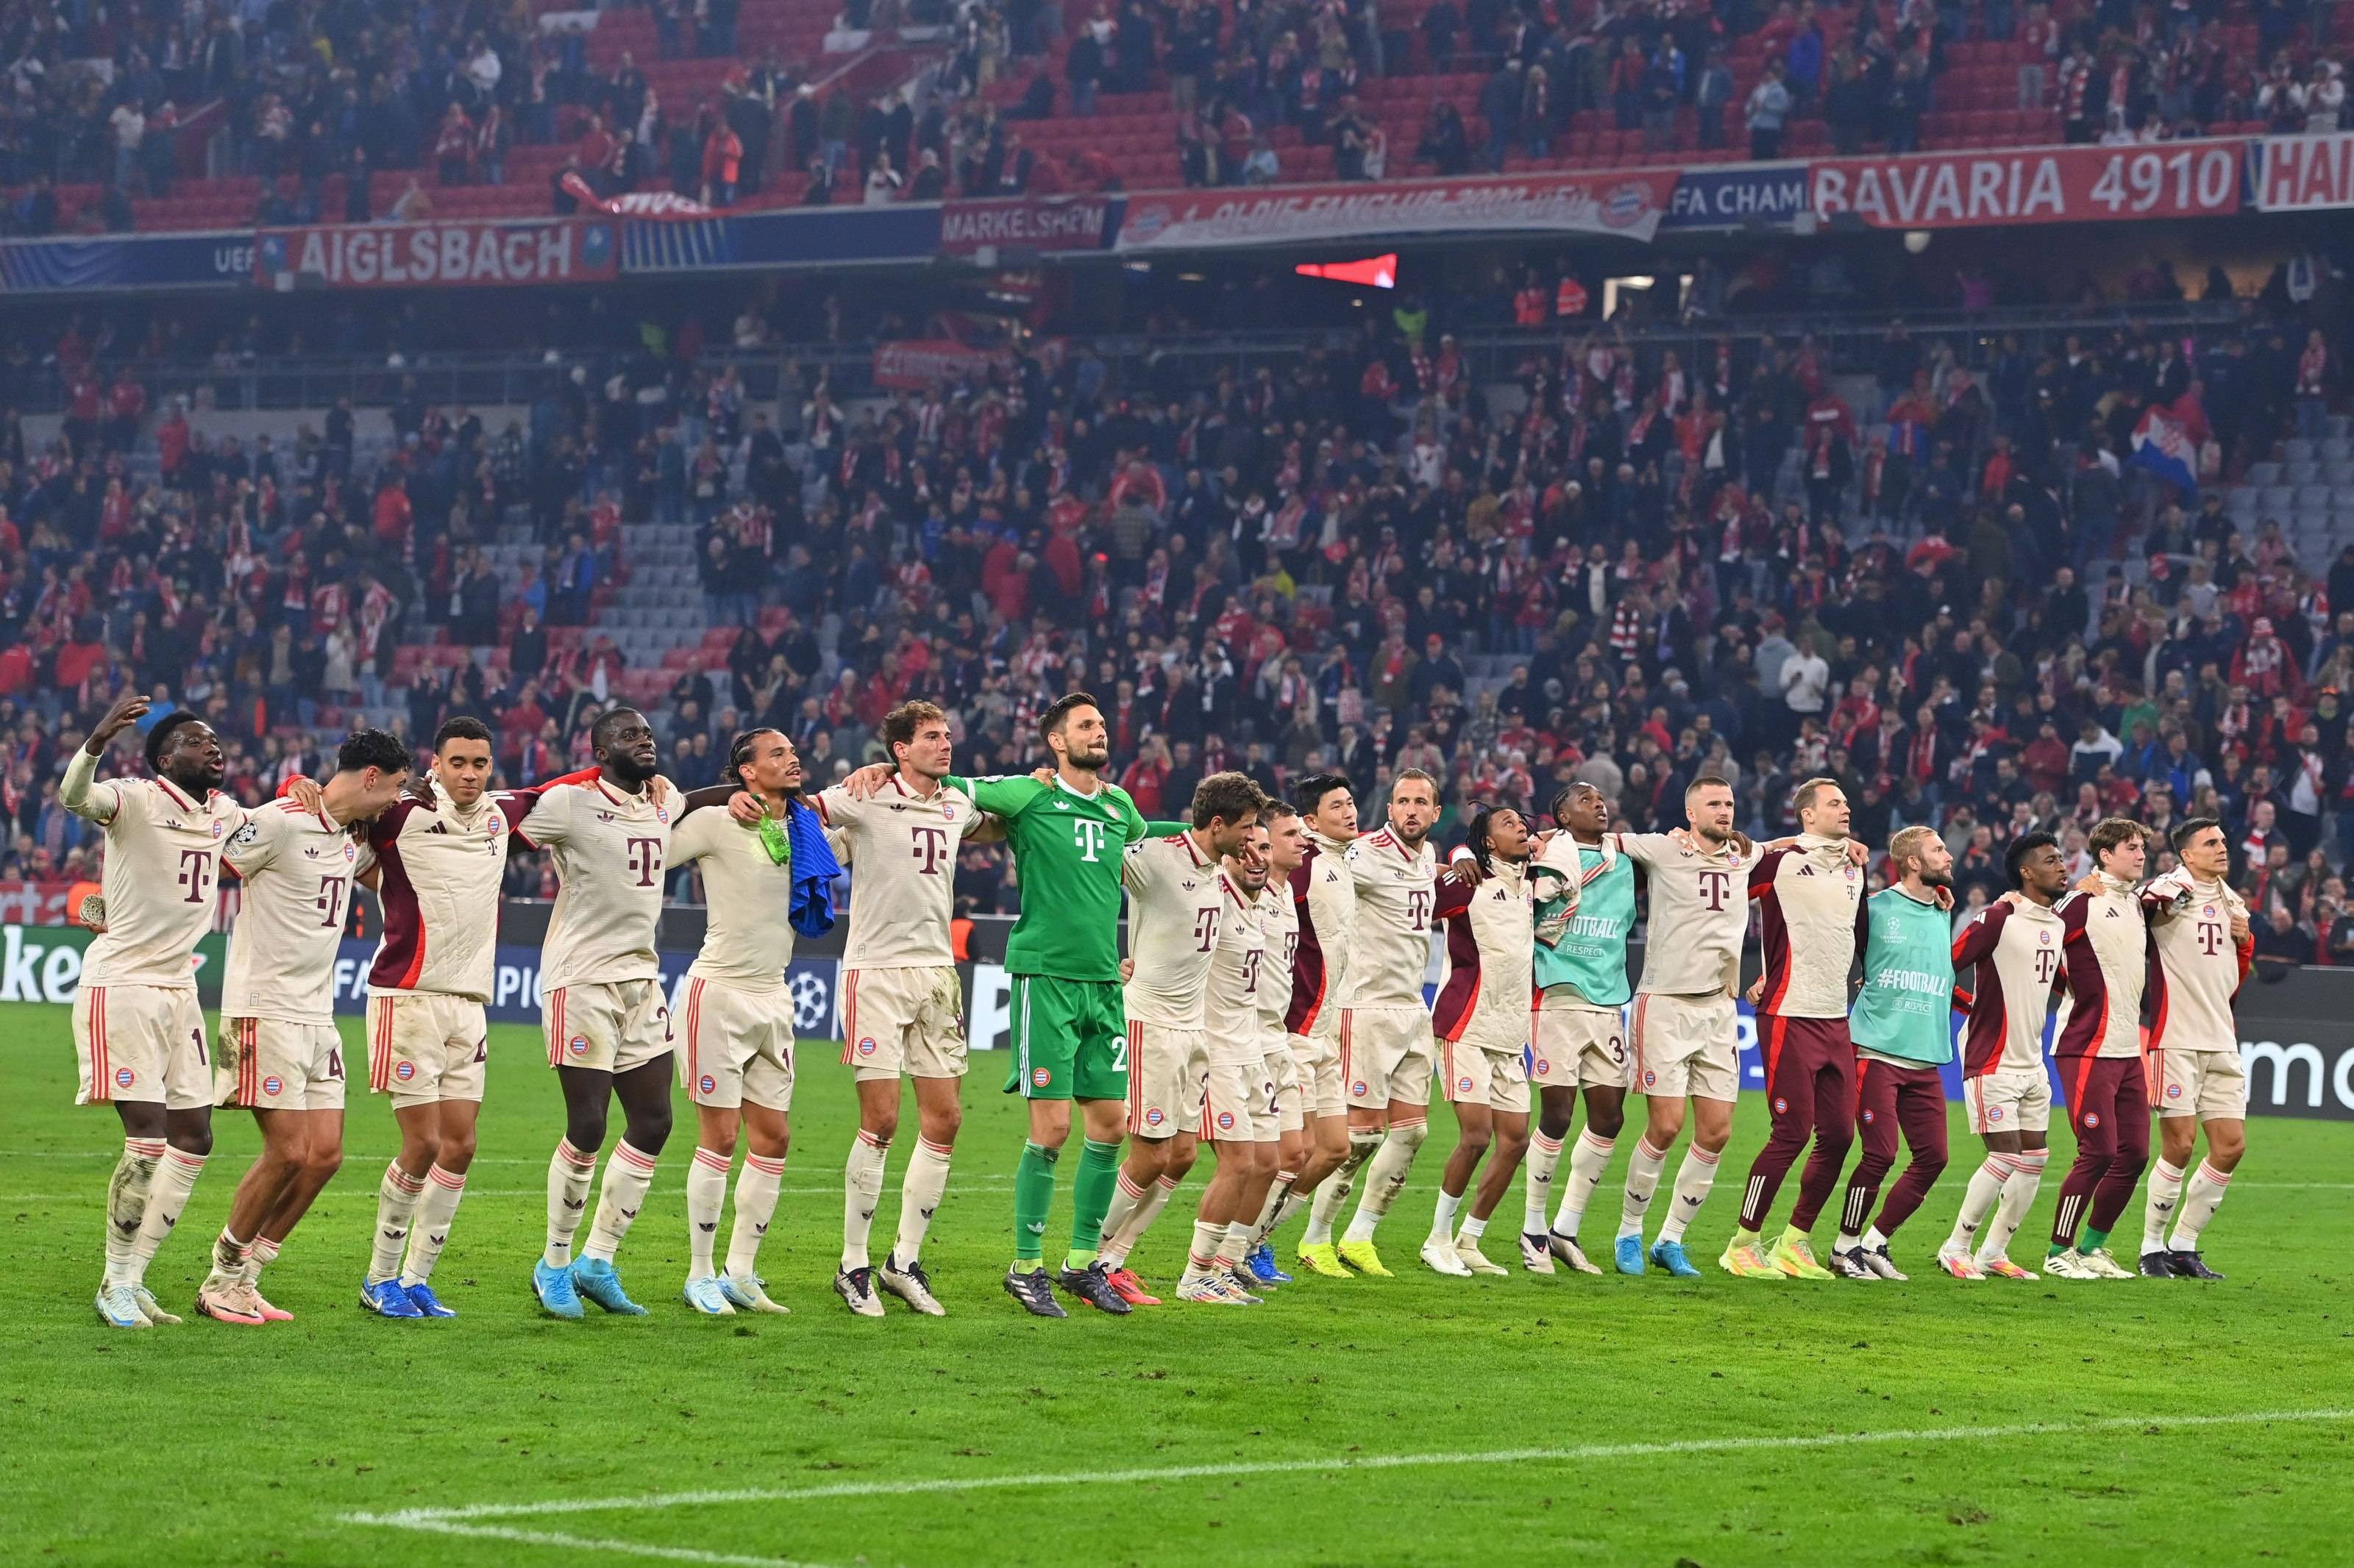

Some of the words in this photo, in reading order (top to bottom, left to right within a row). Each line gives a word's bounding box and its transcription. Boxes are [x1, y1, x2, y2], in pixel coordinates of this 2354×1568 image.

[1813, 157, 2065, 224] BAVARIA
[2089, 150, 2234, 212] 4910
[299, 224, 574, 283] AIGLSBACH
[1566, 944, 1603, 956] RESPECT
[1877, 968, 1946, 997] #FOOTBALL
[1904, 1000, 1933, 1013] RESPECT
[1608, 1036, 1625, 1064] 3
